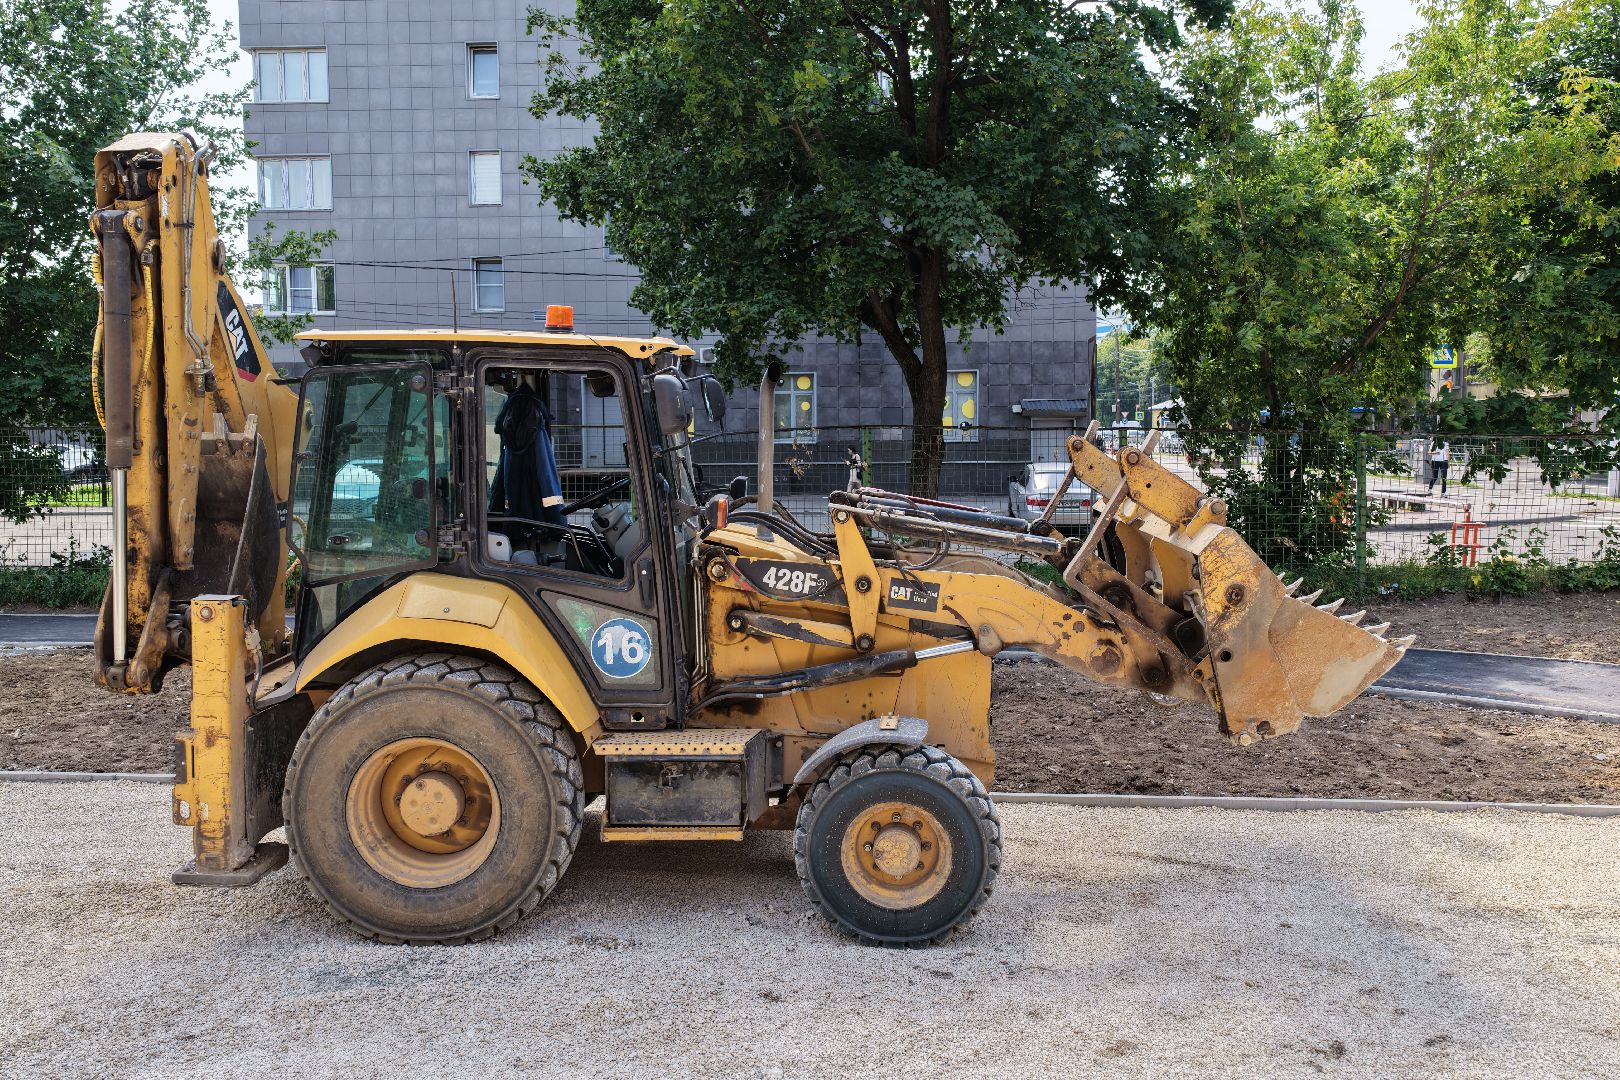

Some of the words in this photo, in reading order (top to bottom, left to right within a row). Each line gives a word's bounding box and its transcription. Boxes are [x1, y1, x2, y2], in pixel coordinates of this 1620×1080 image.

[225, 308, 249, 360] CAT
[890, 585, 913, 600] CAT
[598, 631, 643, 664] 16
